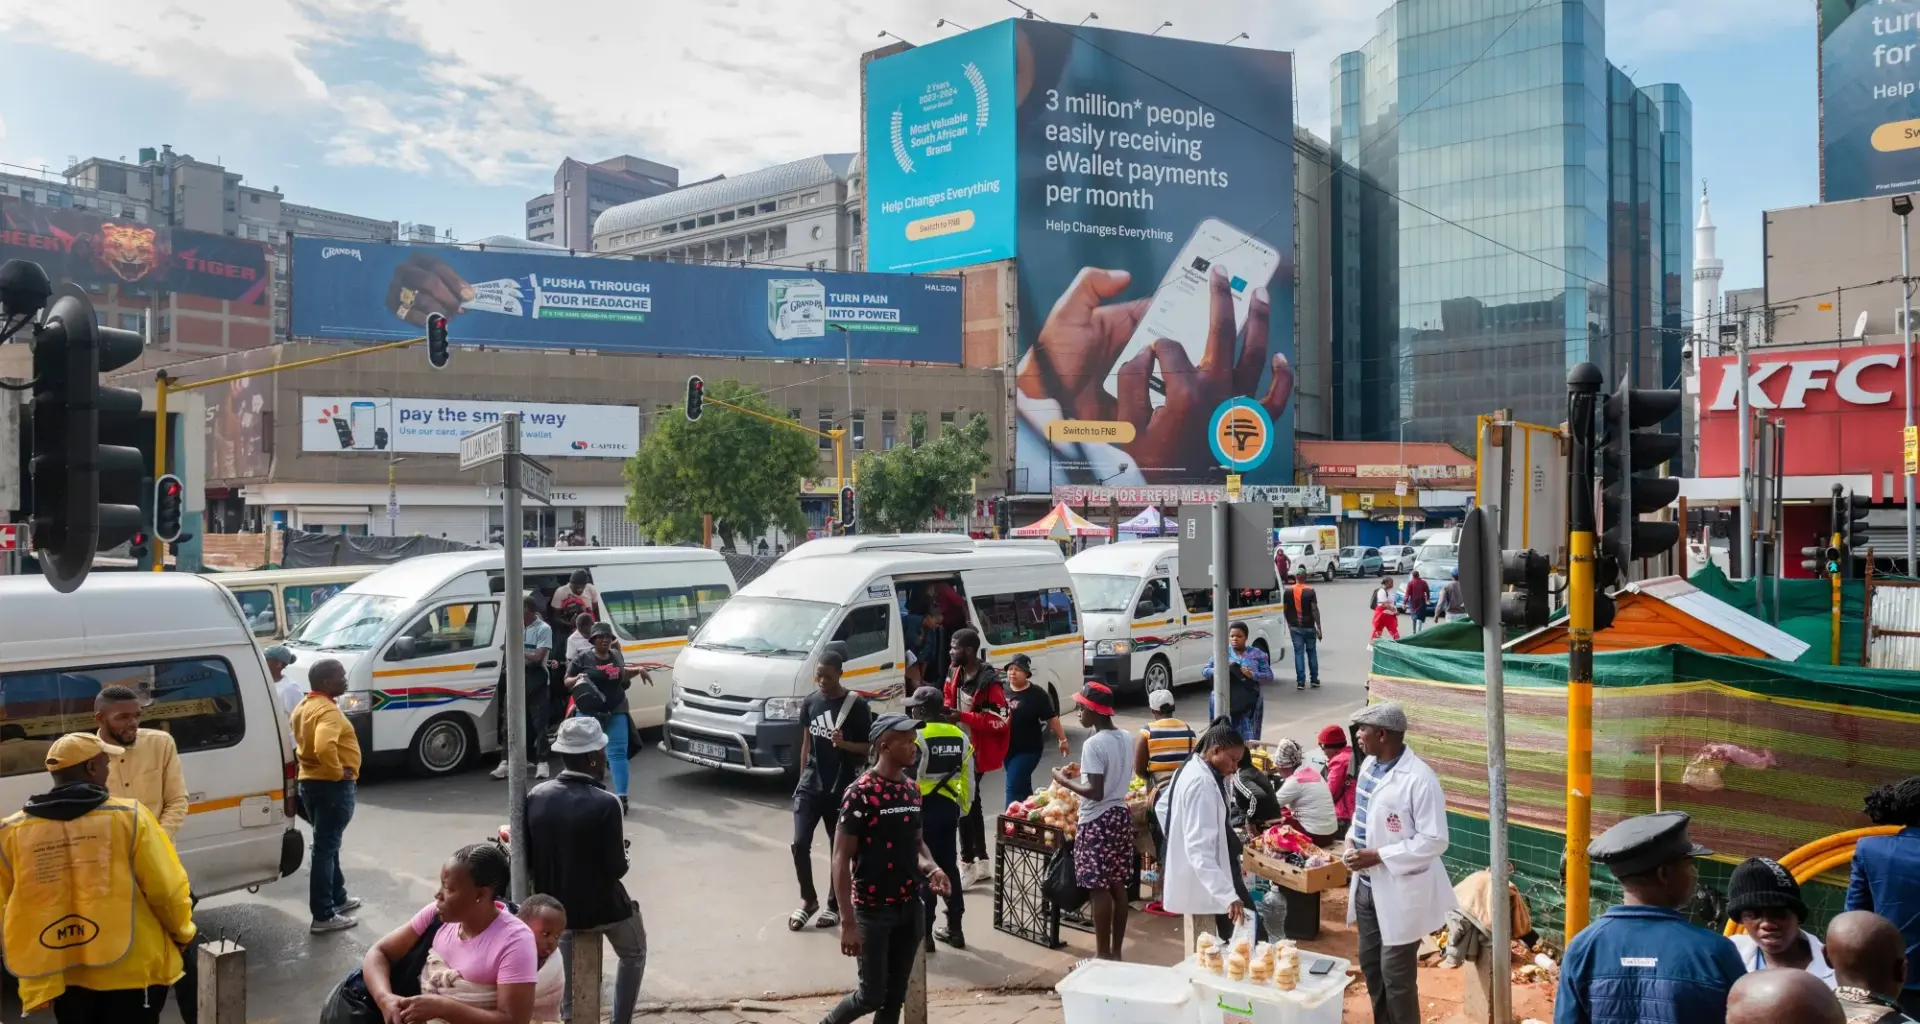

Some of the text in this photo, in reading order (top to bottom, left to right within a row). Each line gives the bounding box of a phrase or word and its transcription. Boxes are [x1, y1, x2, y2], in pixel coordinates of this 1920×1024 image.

[1872, 44, 1917, 68] for
[932, 81, 950, 91] Years
[1873, 81, 1915, 100] Help
[919, 88, 958, 104] 2023-2024
[1045, 88, 1059, 111] 3
[1147, 105, 1216, 131] people
[909, 112, 969, 135] Most Valuable
[910, 126, 968, 148] South African
[1045, 123, 1203, 161] easily receiving
[926, 141, 952, 156] Brand
[1045, 151, 1229, 188] eWallet payments
[1875, 180, 1916, 190] First National
[881, 179, 1000, 214] Help Changes Everything
[1045, 184, 1154, 210] per month
[919, 217, 960, 233] Switch to FNB
[1045, 219, 1174, 242] Help Changes Everything
[321, 246, 362, 261] GRAND-PA
[179, 248, 256, 281] TIGER
[542, 277, 650, 293] PUSHA THROUGH
[924, 283, 957, 292] HALEON
[543, 294, 649, 309] YOUR HEADACHE
[790, 299, 823, 312] GRAND-PA
[829, 293, 888, 304] TURN PAIN
[829, 309, 897, 320] INTO POWER
[1708, 354, 1901, 411] KFC
[400, 408, 566, 428] pay the smt way
[400, 427, 416, 435] Use
[435, 428, 457, 436] card,
[526, 431, 552, 439] wallet
[1063, 426, 1117, 436] Switch to FNB
[590, 442, 629, 450] CAPITEC
[1074, 488, 1137, 502] SUPERIOR
[1140, 488, 1178, 502] FRESH
[1181, 487, 1220, 502] MEATS
[57, 924, 85, 941] MTN
